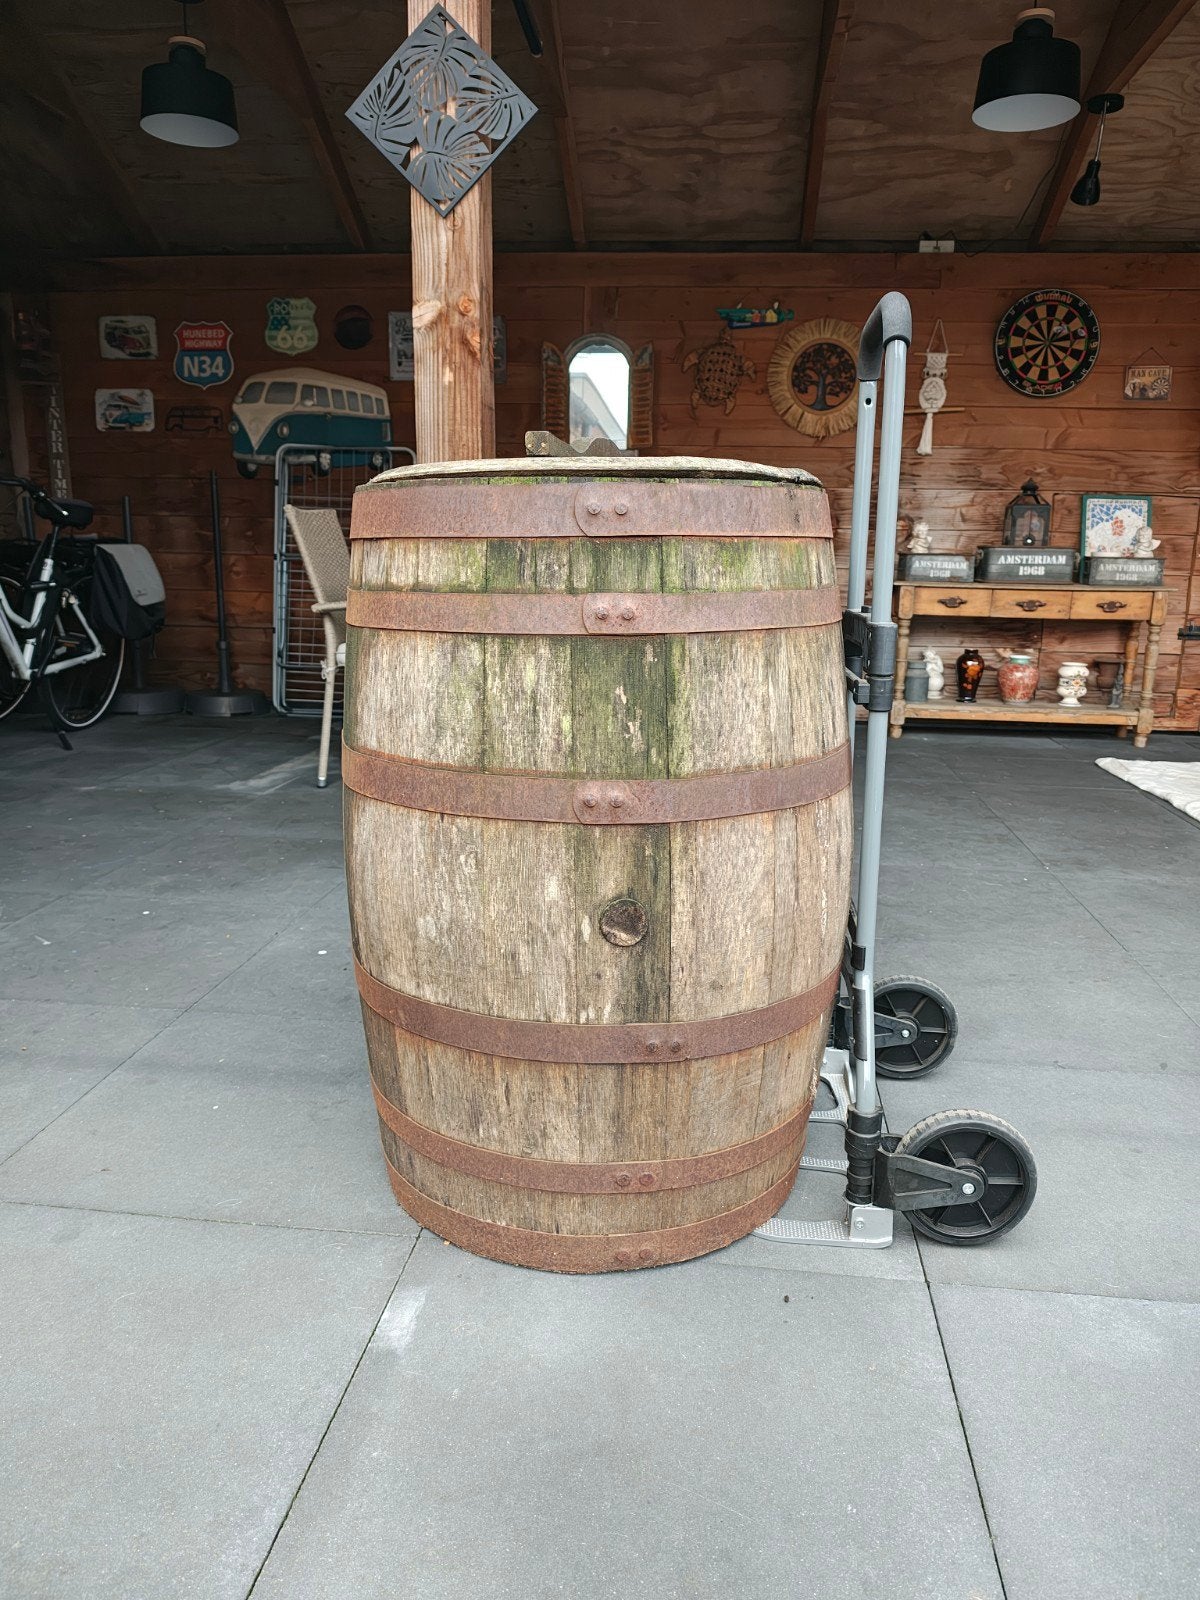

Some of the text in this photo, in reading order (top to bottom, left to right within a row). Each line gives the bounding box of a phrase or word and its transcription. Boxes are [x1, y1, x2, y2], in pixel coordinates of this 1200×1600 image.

[183, 328, 225, 339] HUNEBED
[277, 325, 308, 349] 66
[184, 339, 223, 348] HIGHWAY
[183, 355, 225, 378] N34
[998, 554, 1066, 565] AMSTERDAM
[913, 560, 967, 570] AMSTERDAM
[1099, 563, 1156, 573] AMSTERDAM
[929, 569, 951, 578] 1968
[1018, 566, 1046, 576] 1968
[1115, 572, 1138, 581] 1968
